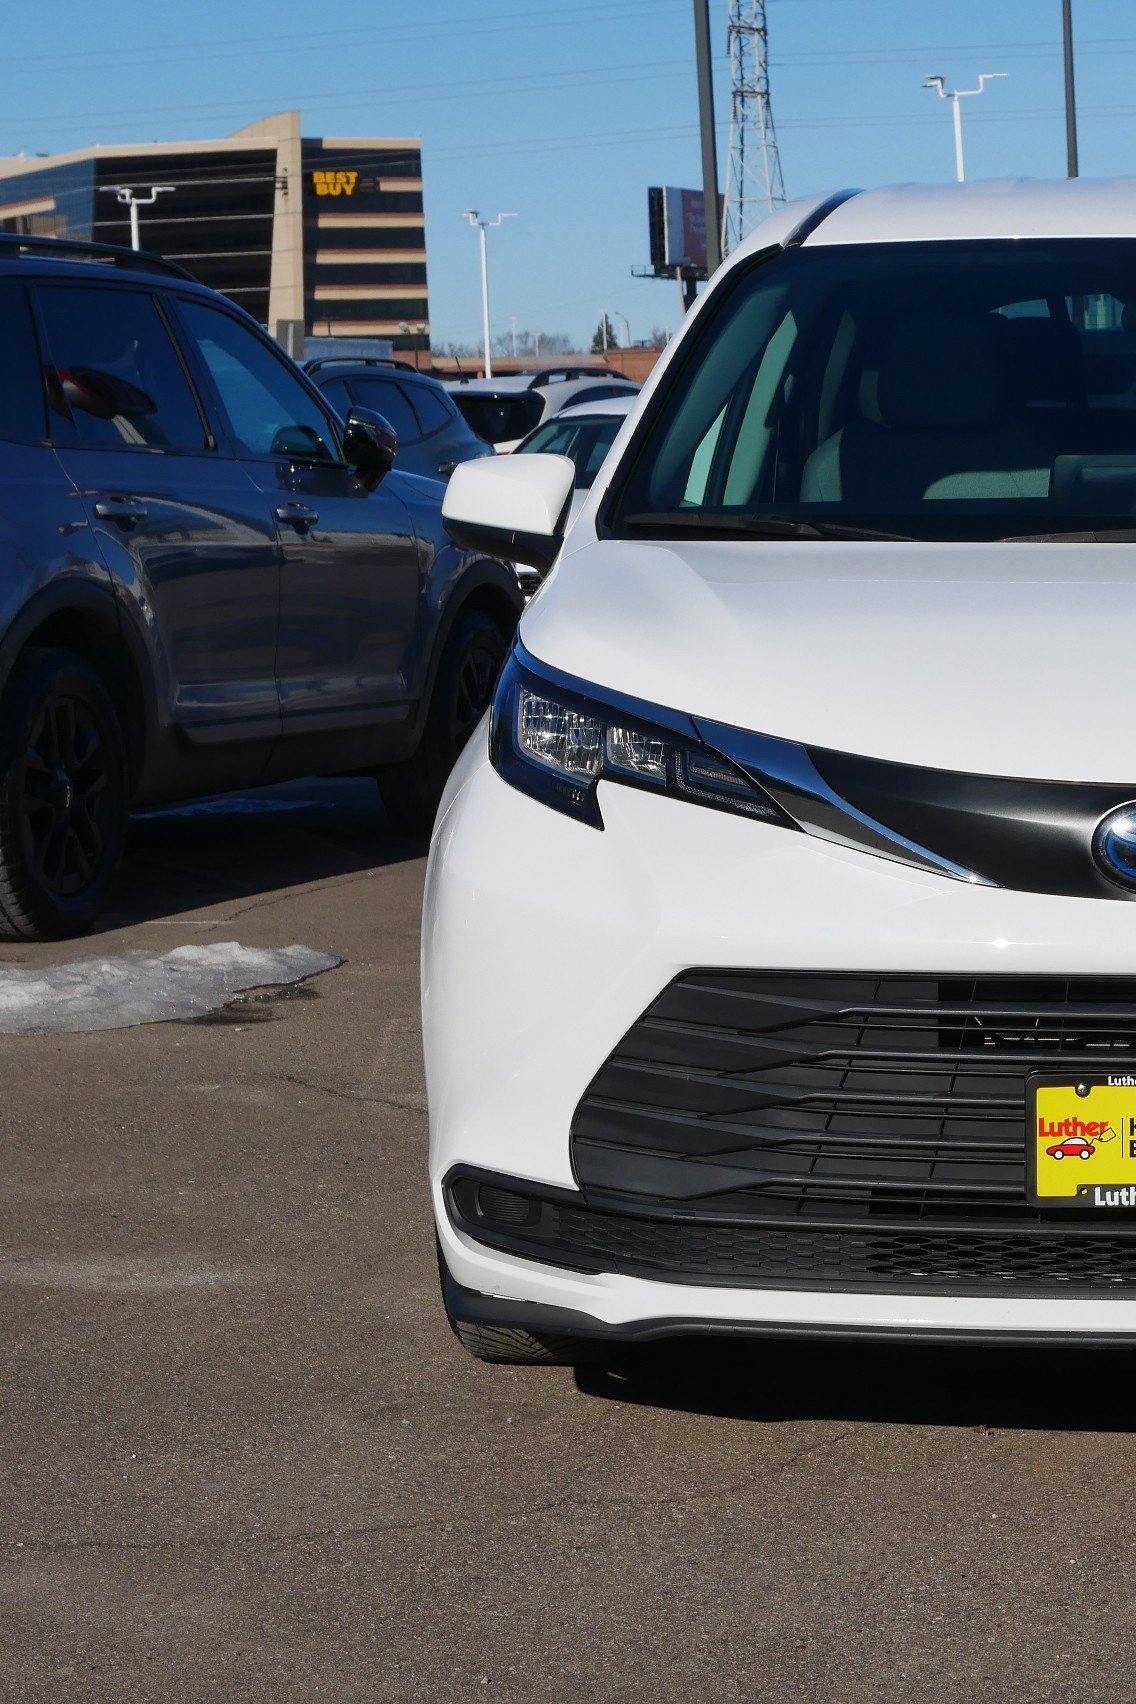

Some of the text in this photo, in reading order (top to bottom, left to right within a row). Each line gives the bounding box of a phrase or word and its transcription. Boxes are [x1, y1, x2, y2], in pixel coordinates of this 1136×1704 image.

[313, 171, 358, 183] BEST
[316, 182, 356, 195] BUY
[1038, 1117, 1109, 1137] Luther
